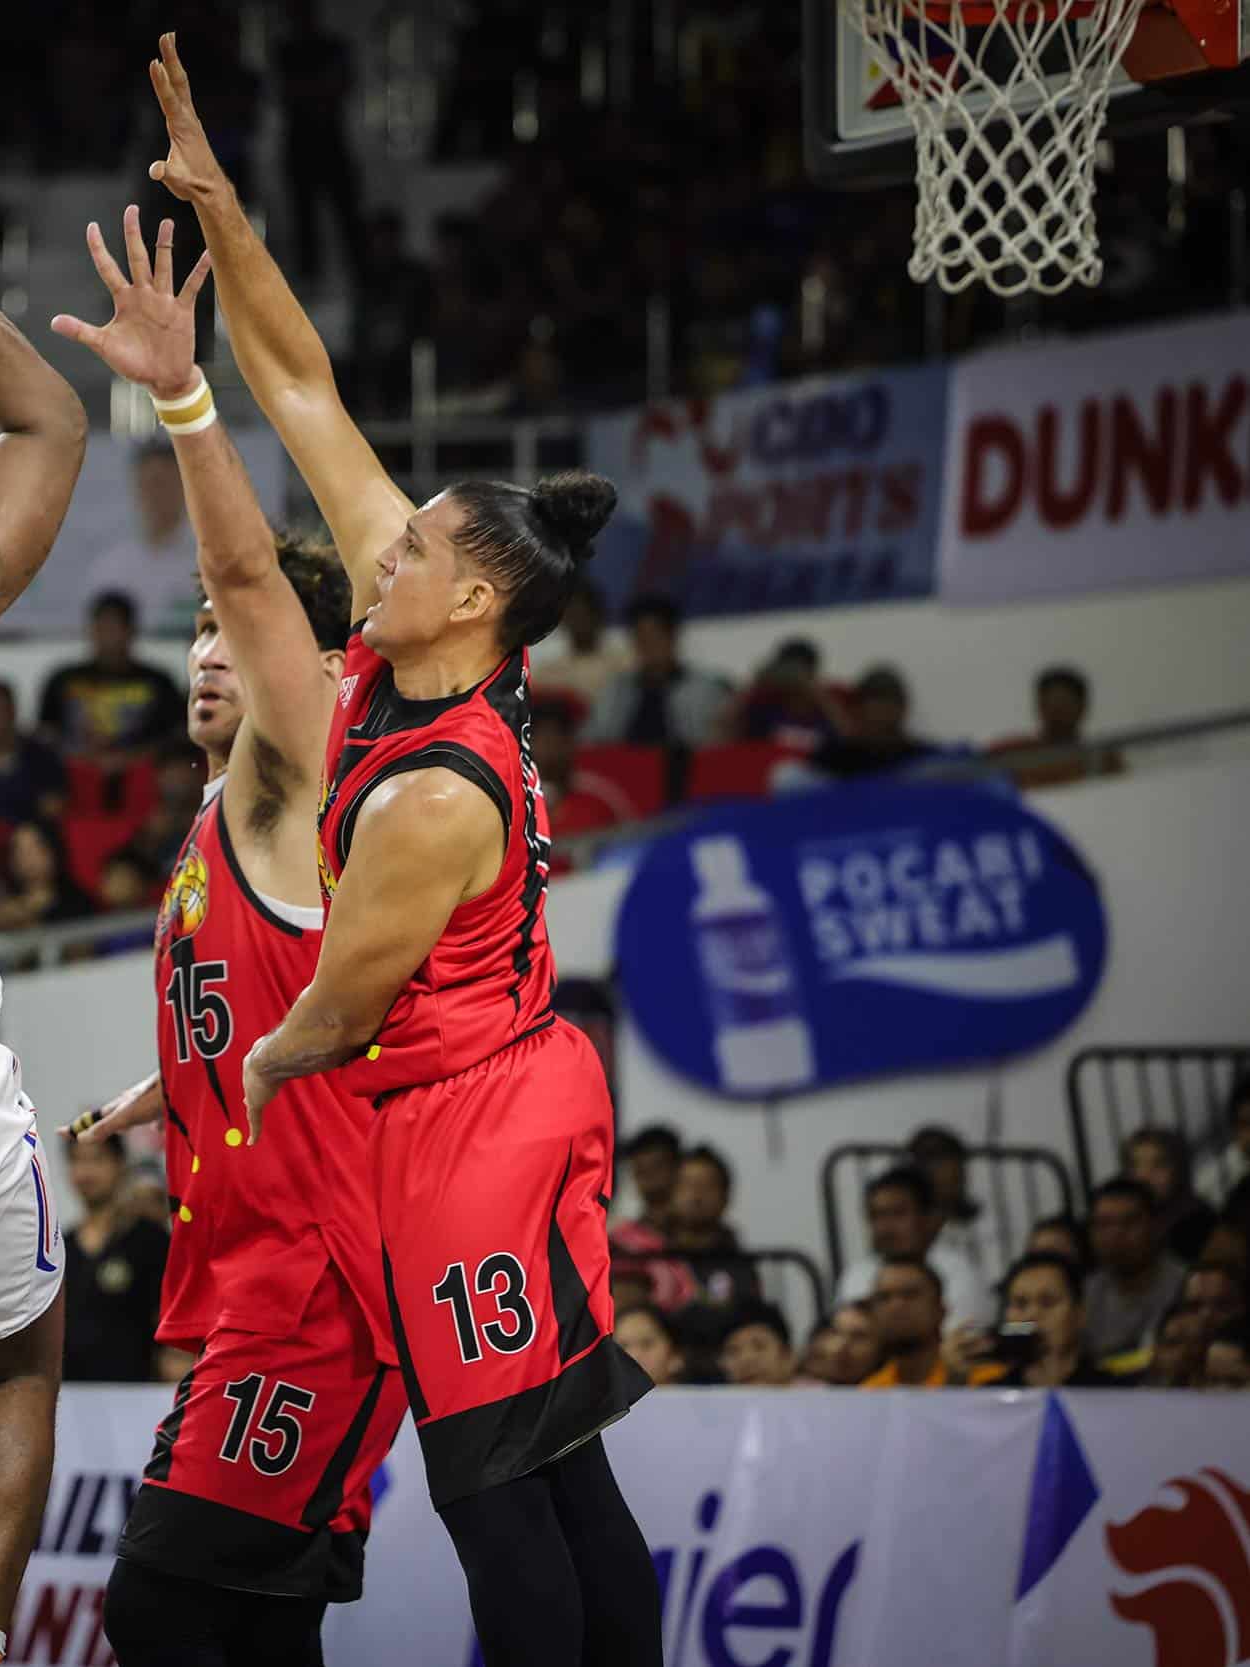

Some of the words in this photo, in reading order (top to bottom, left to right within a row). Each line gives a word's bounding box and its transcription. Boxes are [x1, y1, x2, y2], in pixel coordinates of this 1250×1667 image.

[799, 829, 1044, 910] POCARI
[811, 870, 1026, 962] SWEAT
[165, 959, 234, 1064] 15
[432, 1251, 537, 1364] 13
[218, 1371, 317, 1477] 15
